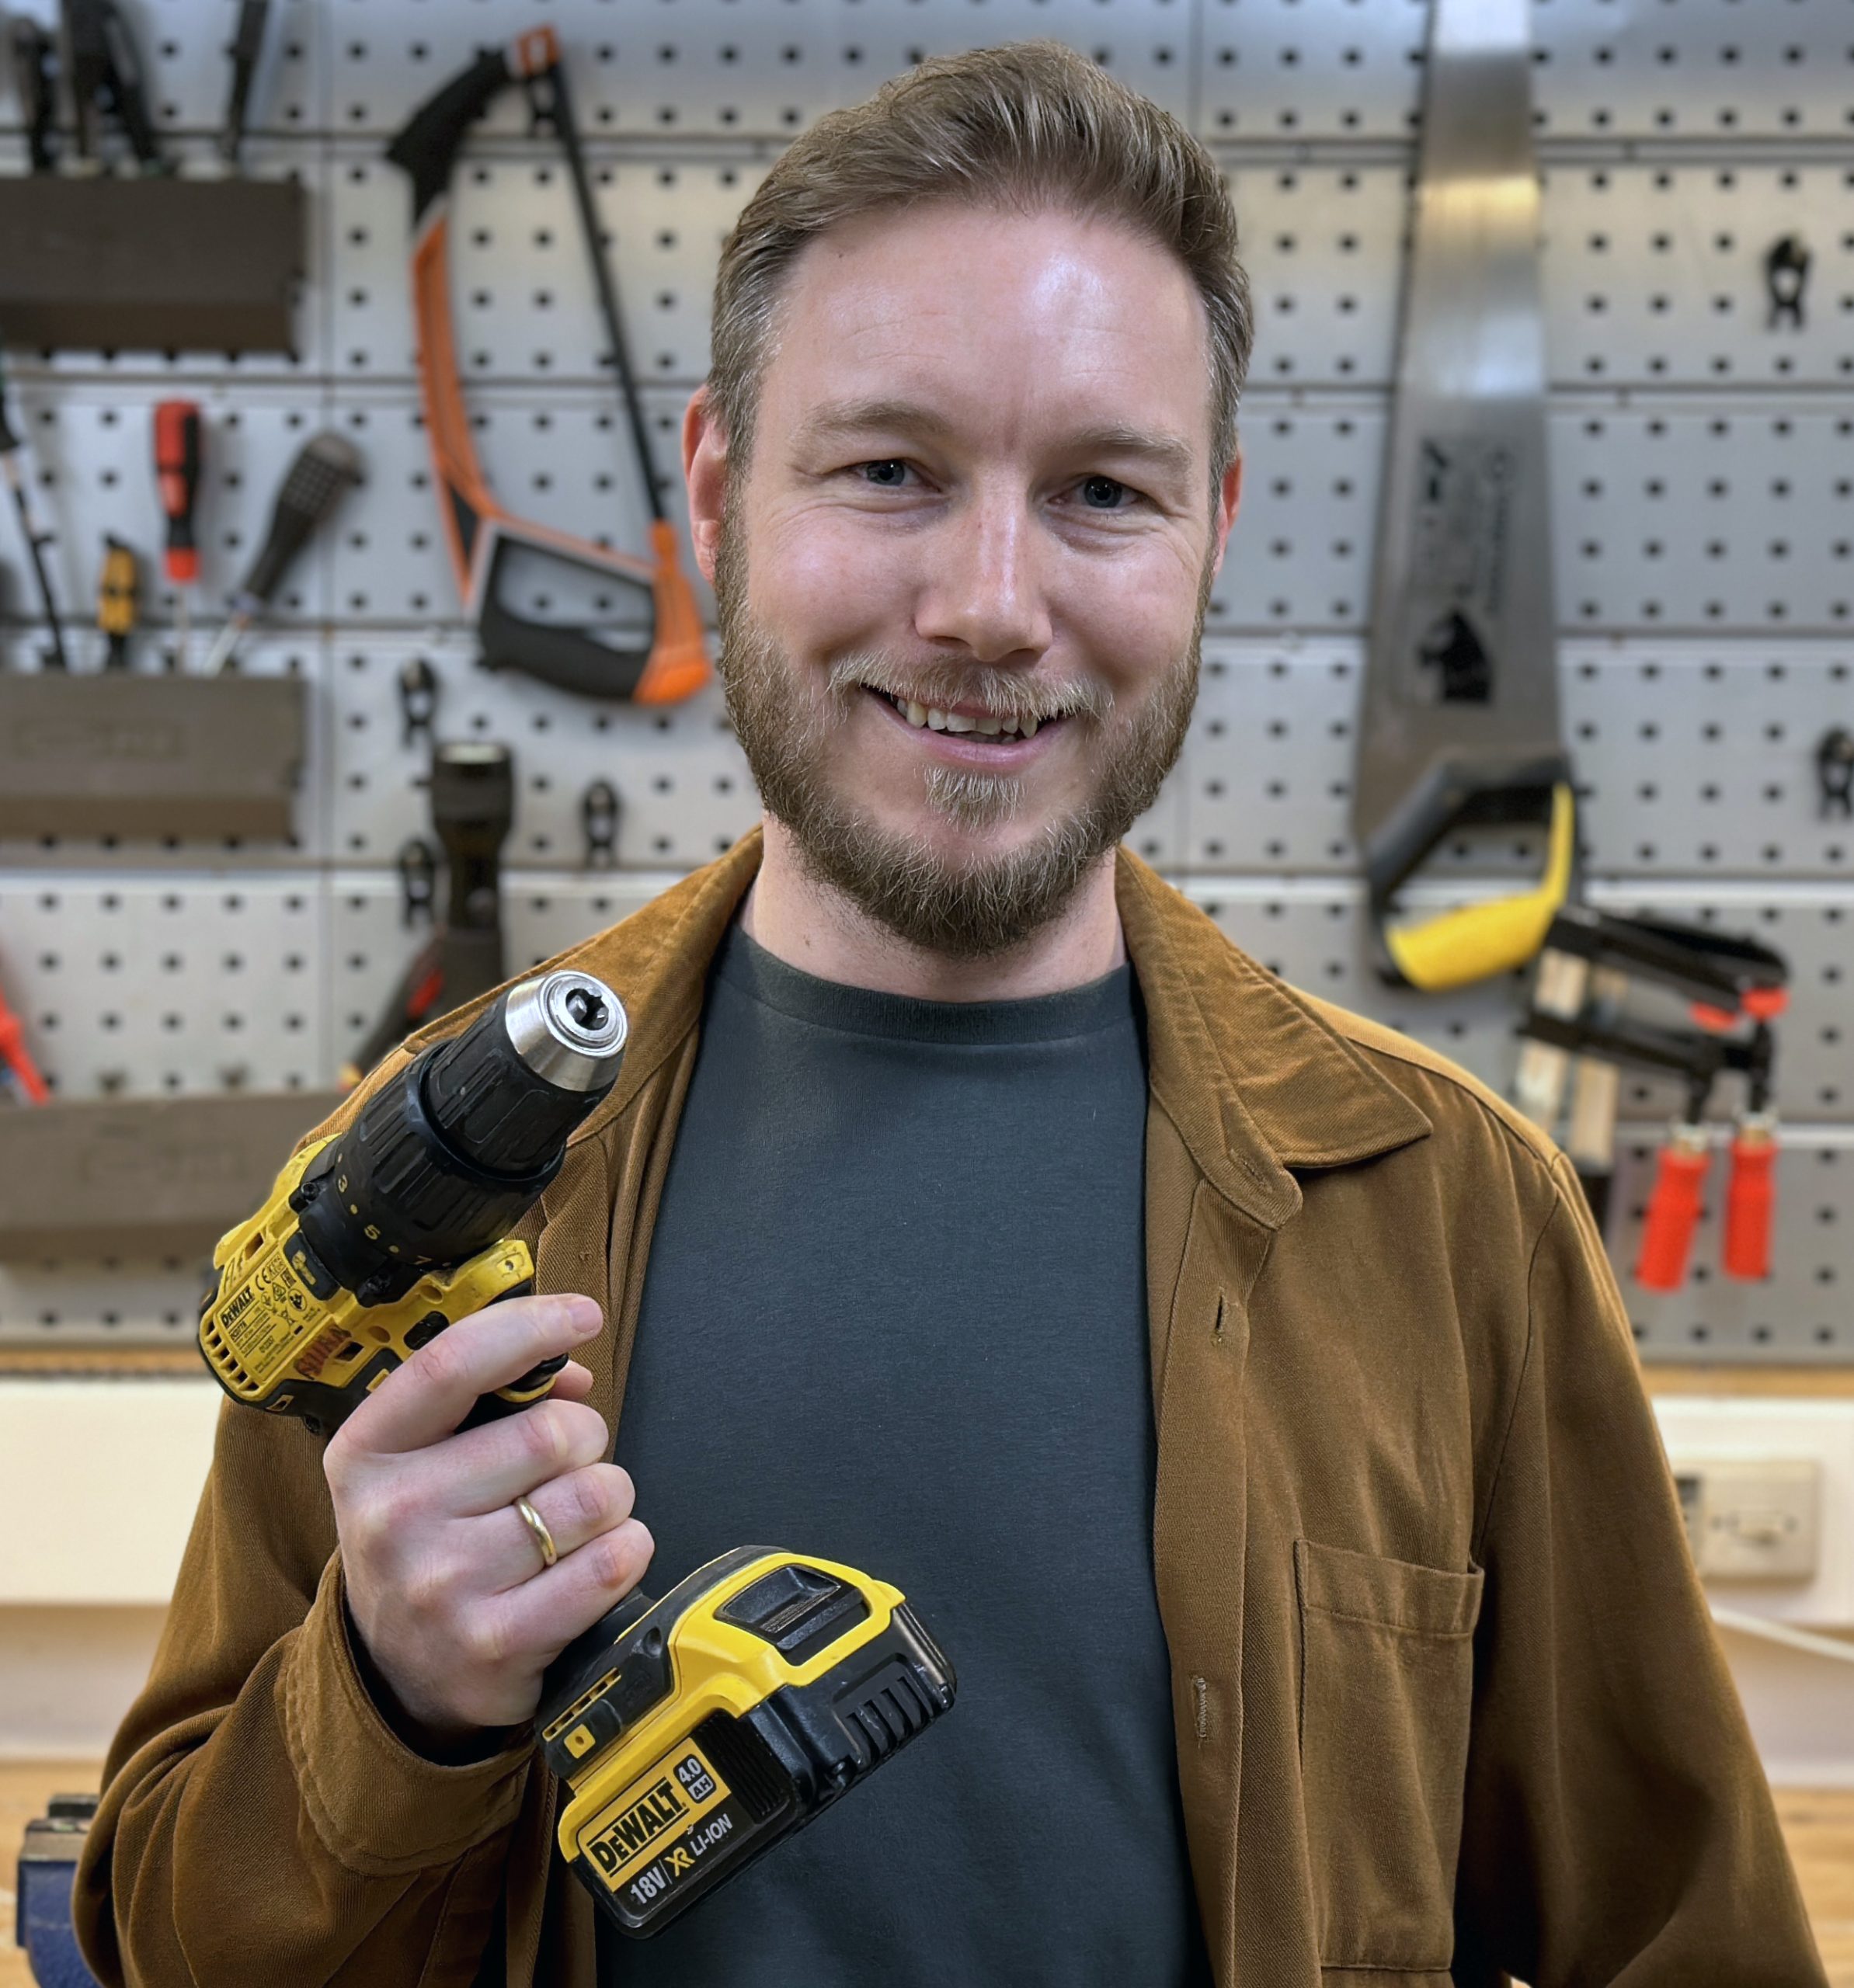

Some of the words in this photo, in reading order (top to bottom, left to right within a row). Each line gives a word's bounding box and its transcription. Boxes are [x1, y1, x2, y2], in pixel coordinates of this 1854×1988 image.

[364, 1224, 381, 1240] 5
[678, 1758, 702, 1784] 4.0
[692, 1776, 711, 1799] AH
[690, 1813, 733, 1857] LI-ION
